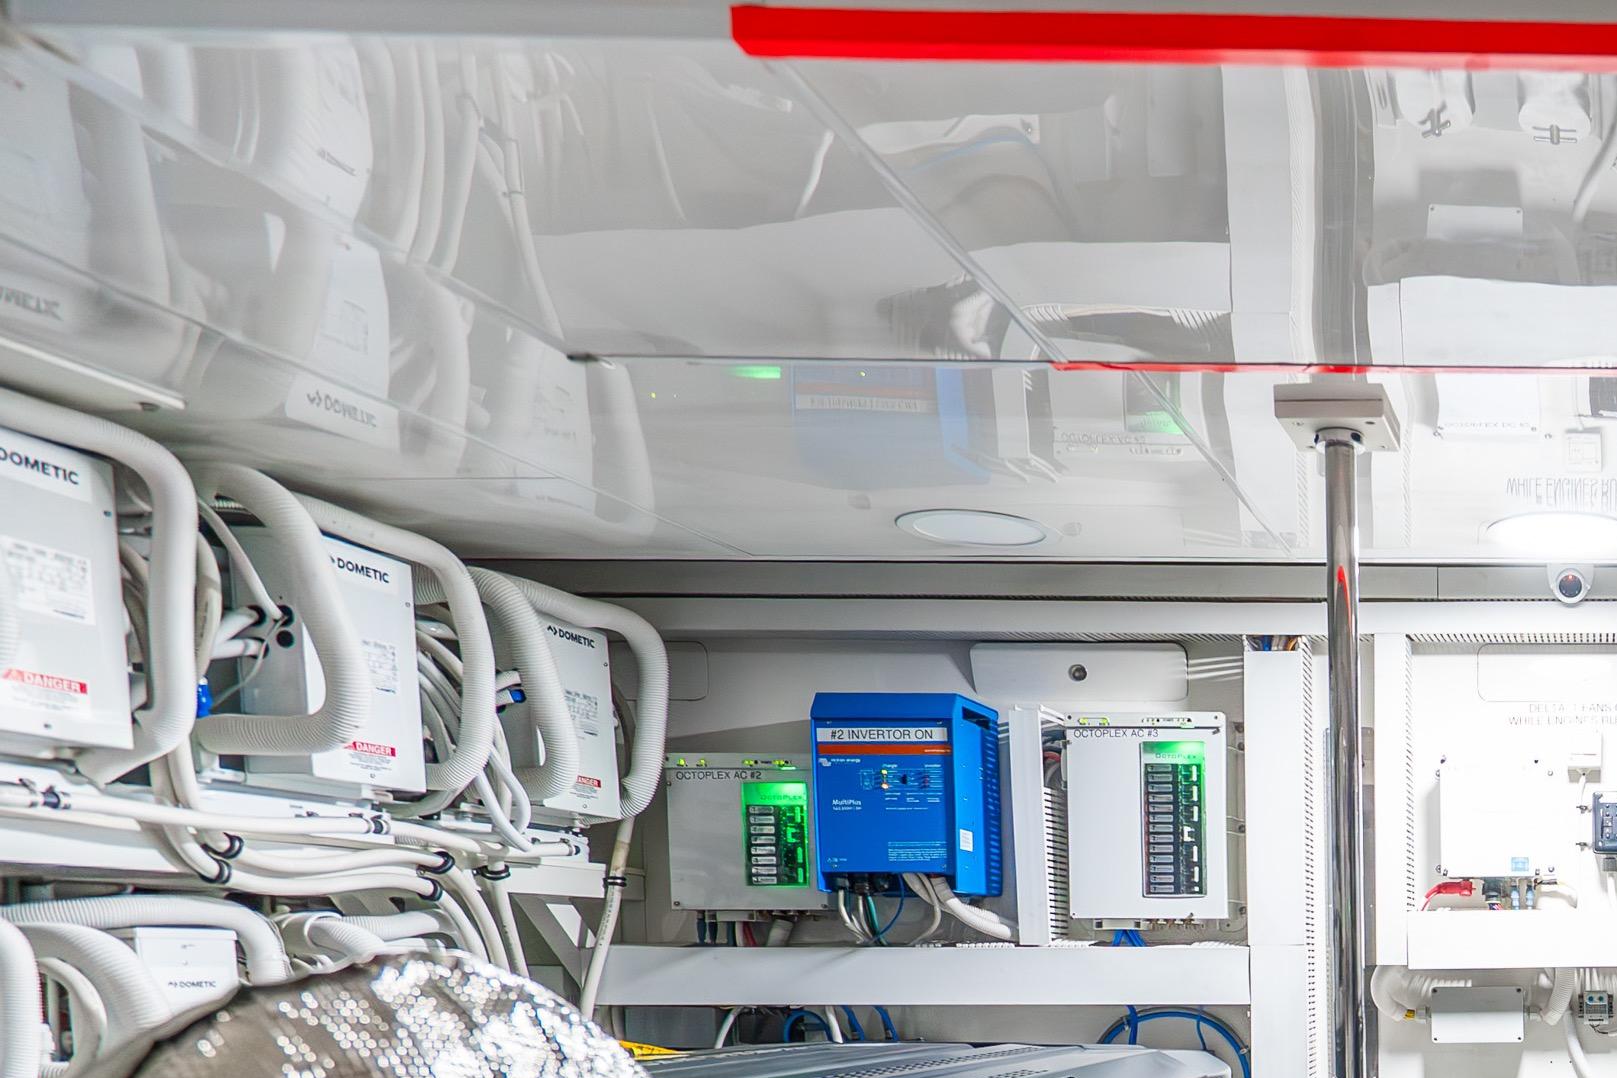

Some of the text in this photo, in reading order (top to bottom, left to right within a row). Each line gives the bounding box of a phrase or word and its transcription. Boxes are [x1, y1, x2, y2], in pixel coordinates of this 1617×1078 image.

[337, 557, 390, 583] DOMETIC
[558, 629, 596, 649] DOMETIC
[24, 673, 83, 693] DANGER
[830, 729, 933, 740] #2 INVERTOR ON
[1073, 729, 1159, 738] OCTOPLEX AC #3
[355, 742, 393, 757] DANGER
[676, 771, 762, 780] OCTOPLEX AC #2
[179, 980, 217, 989] DOMETIC
